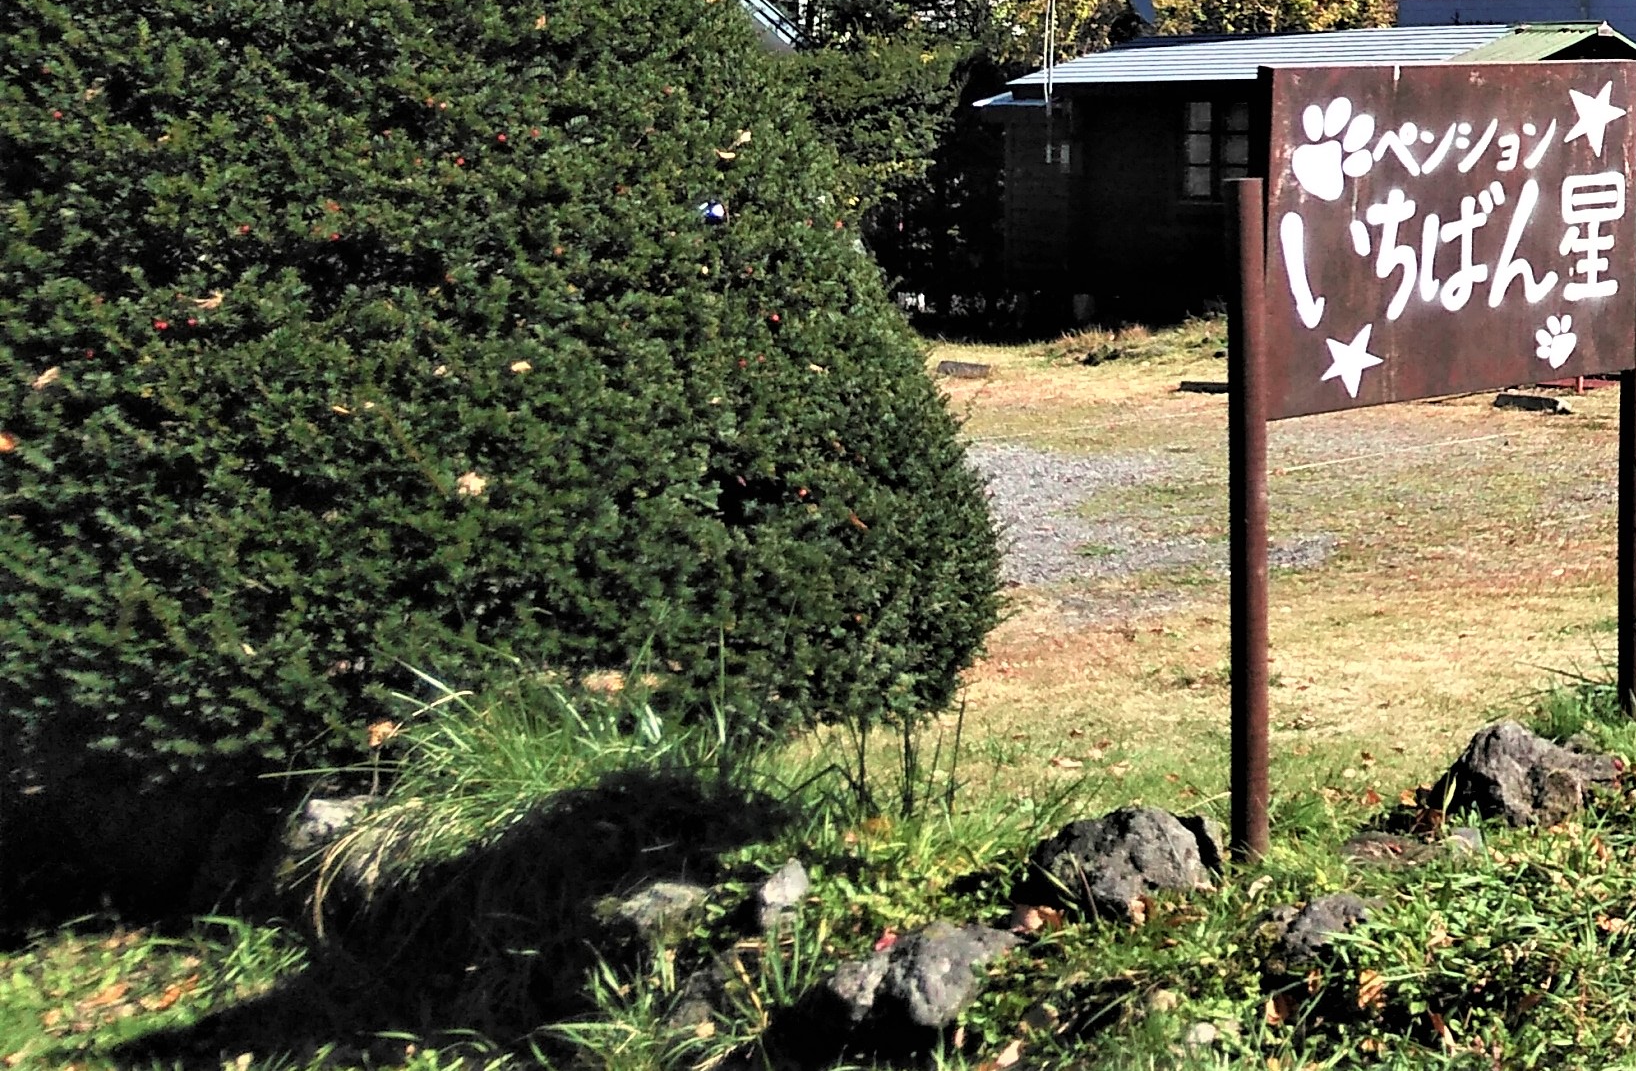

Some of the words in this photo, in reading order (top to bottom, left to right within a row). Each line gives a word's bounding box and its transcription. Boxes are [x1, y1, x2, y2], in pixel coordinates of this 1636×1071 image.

[1373, 118, 1557, 176] ペンション
[1280, 171, 1626, 329] いちばん星
